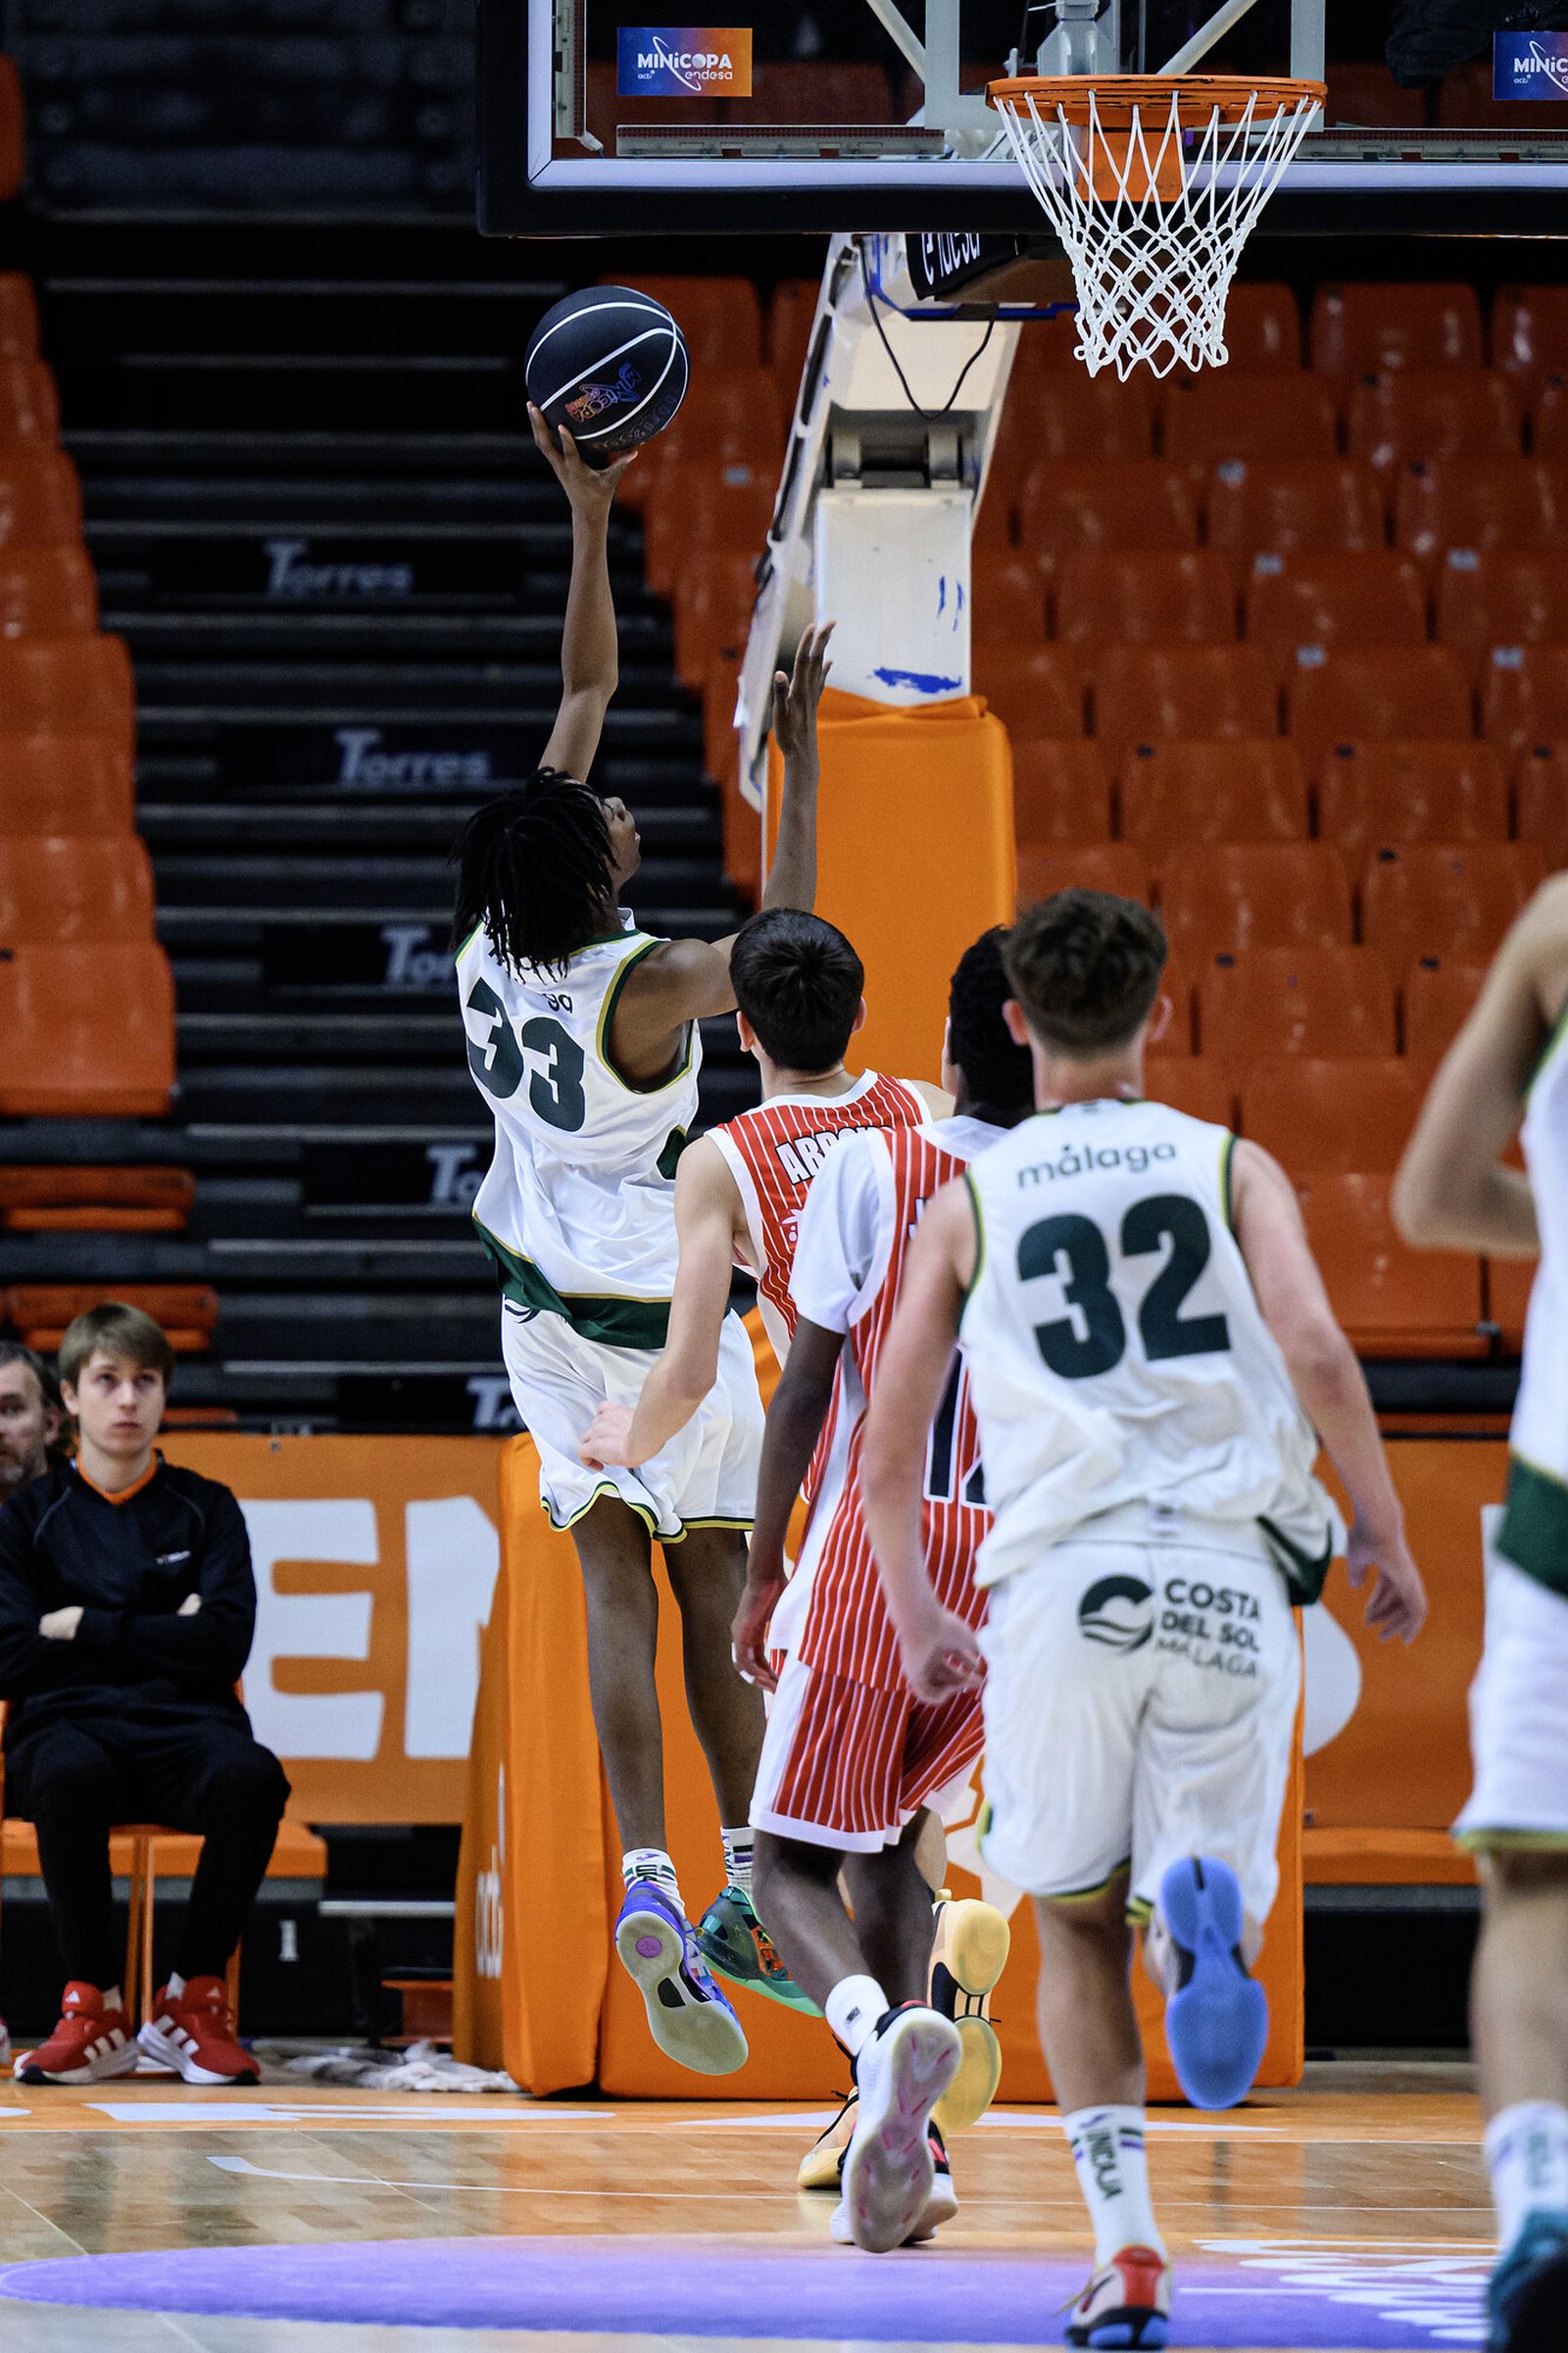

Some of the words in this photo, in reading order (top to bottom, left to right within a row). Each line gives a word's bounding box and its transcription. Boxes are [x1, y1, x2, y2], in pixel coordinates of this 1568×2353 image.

[685, 70, 733, 79] endesa
[1514, 56, 1568, 74] MINiC
[264, 540, 413, 596] Torres
[335, 729, 489, 787] Torres
[466, 976, 586, 1132] 33
[1016, 1193, 1231, 1379] 32
[1164, 1578, 1261, 1619] COSTA
[1161, 1610, 1209, 1640] DEL
[1219, 1622, 1260, 1652] SOL
